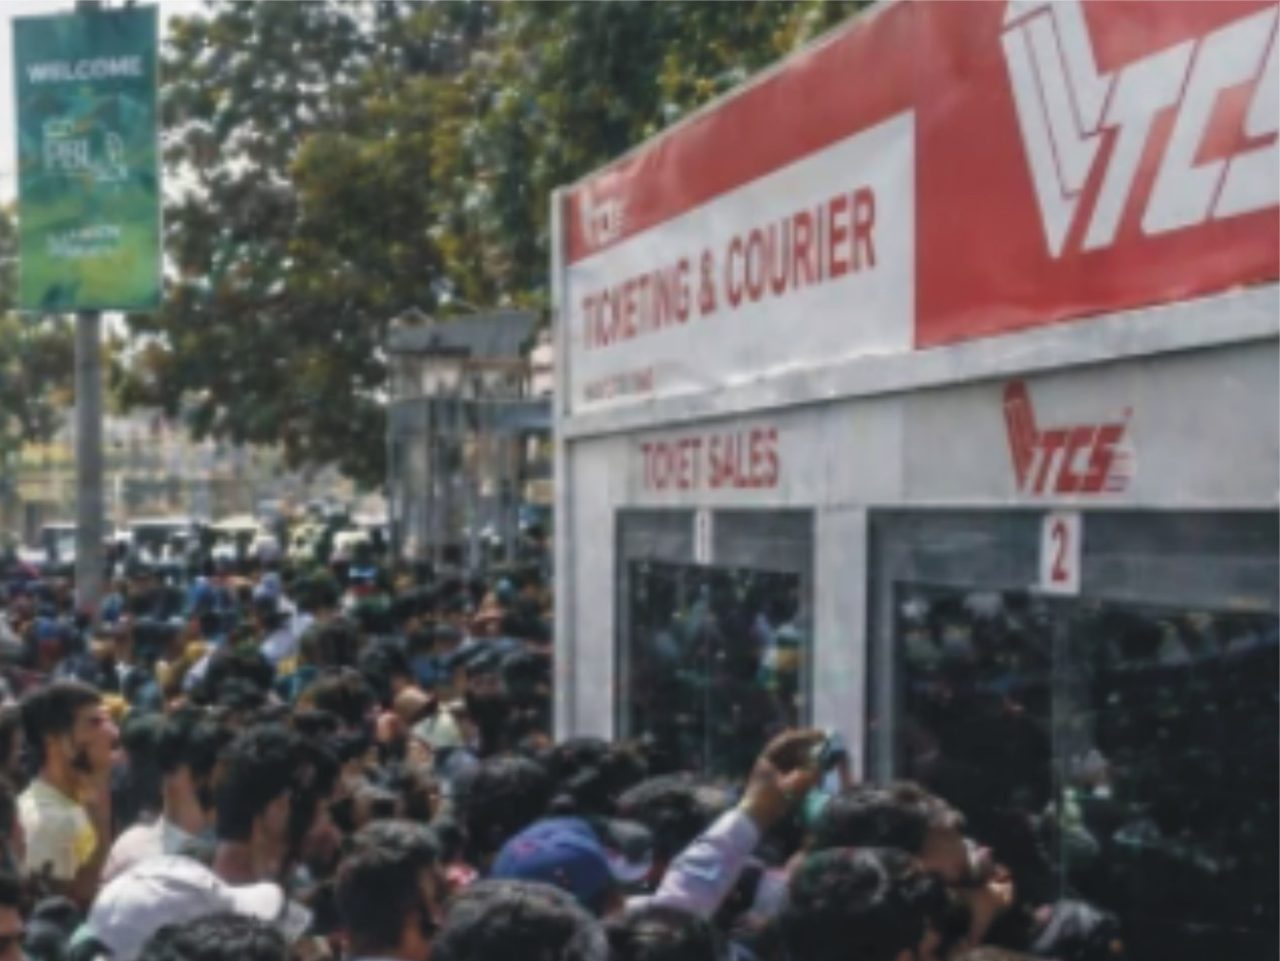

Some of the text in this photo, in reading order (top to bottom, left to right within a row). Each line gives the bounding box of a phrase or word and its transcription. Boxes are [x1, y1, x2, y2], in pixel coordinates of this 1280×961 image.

[26, 56, 144, 83] WELCOME
[583, 257, 690, 347] TICKETING
[698, 247, 717, 316] &
[725, 185, 876, 311] COURIER
[708, 426, 780, 490] SALES
[1051, 519, 1068, 582] 2
